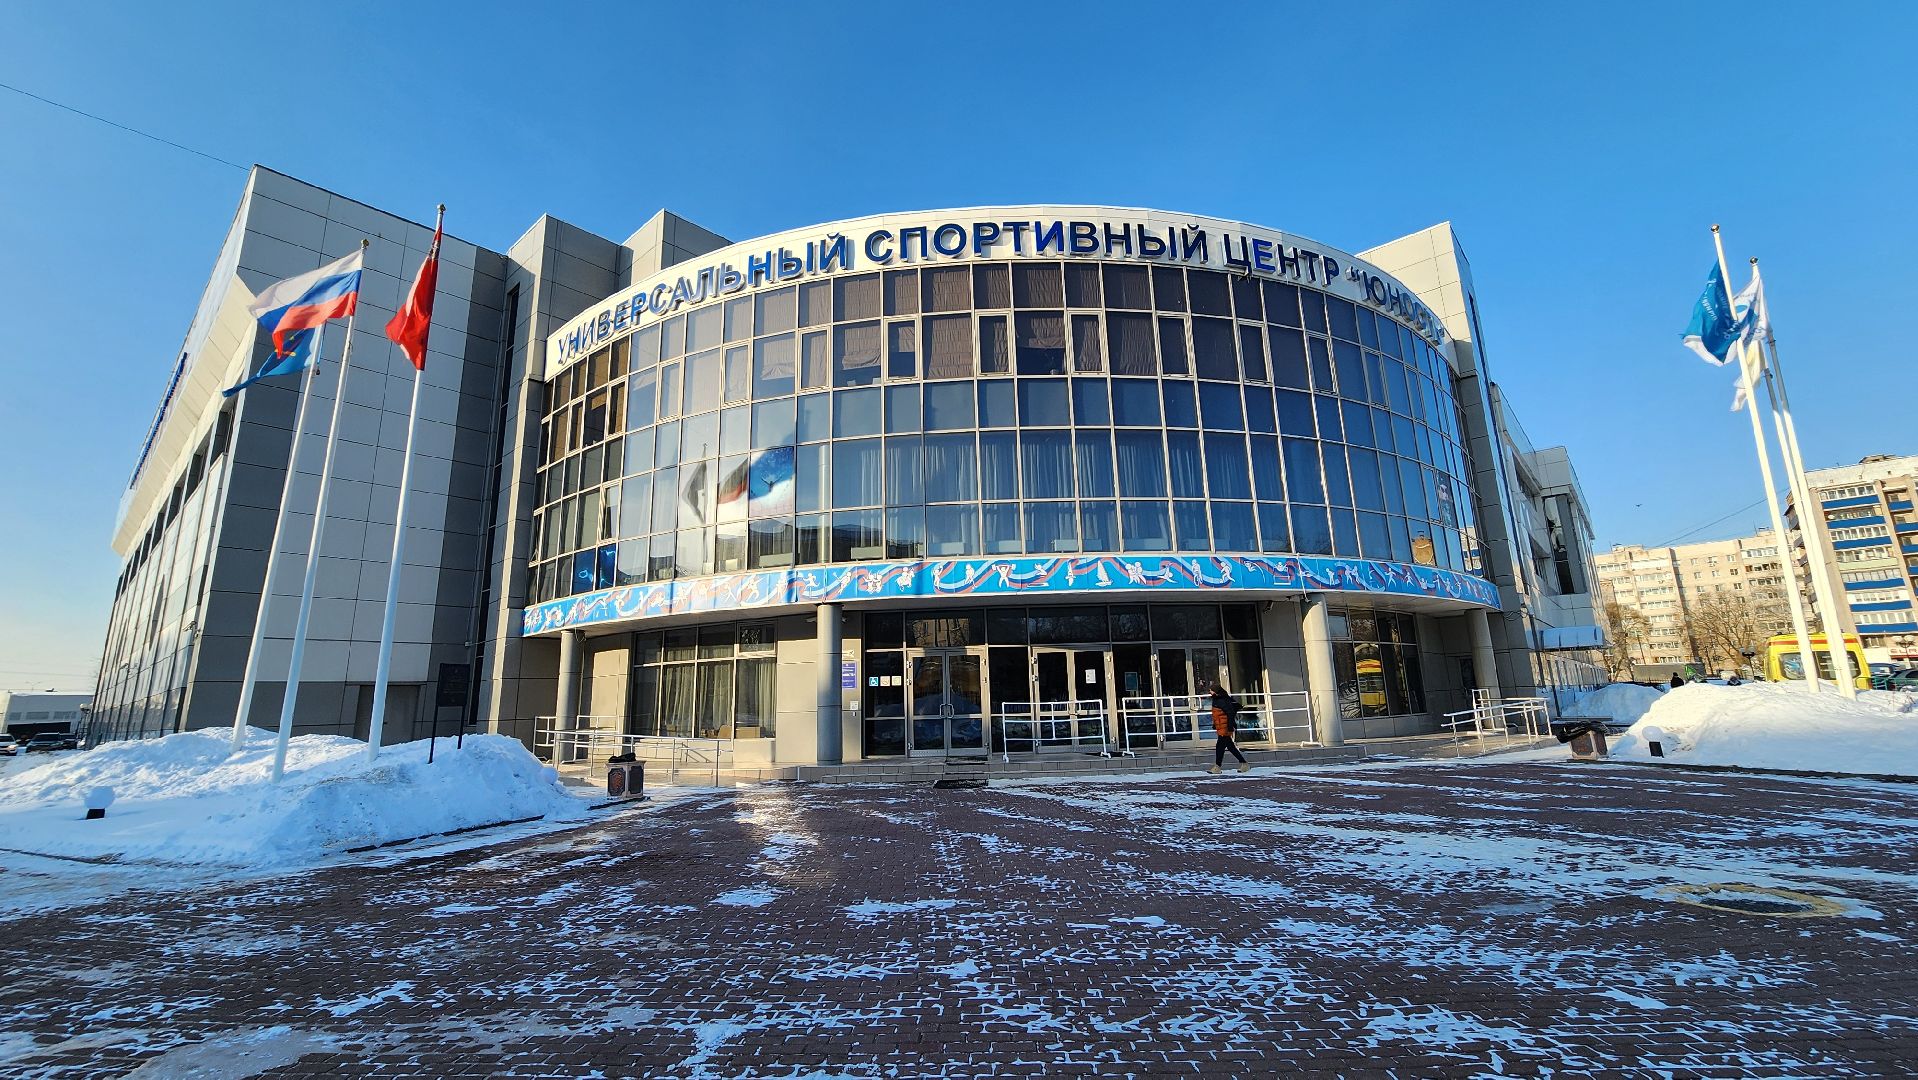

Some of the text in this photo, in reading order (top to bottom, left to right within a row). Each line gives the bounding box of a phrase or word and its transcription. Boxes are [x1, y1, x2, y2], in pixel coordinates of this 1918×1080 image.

[558, 232, 851, 365] УНИВЕРСАЛЬНЫЙ
[865, 220, 1209, 264] СПОРТИВНЫЙ
[1223, 234, 1340, 287] ЦЕНТР
